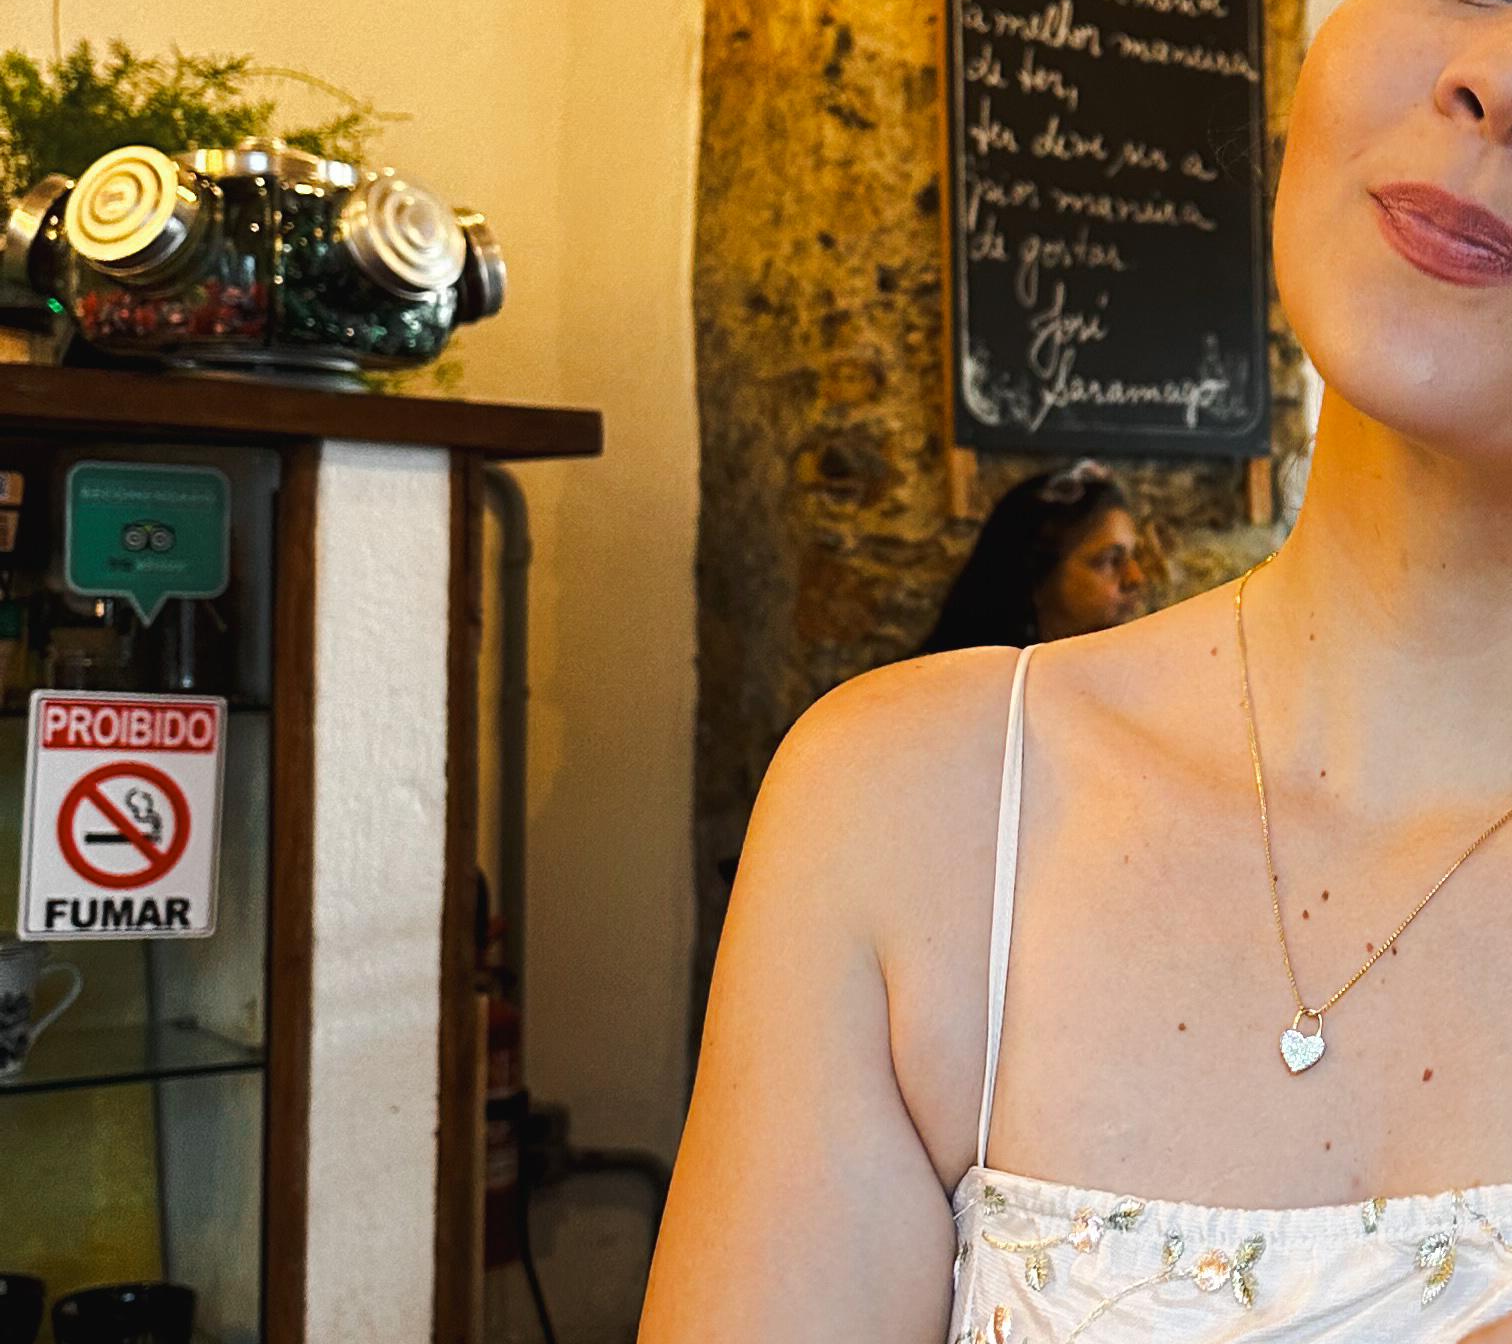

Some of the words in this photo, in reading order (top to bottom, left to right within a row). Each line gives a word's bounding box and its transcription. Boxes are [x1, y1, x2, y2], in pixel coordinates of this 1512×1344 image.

[967, 44, 1008, 89] de
[1106, 31, 1259, 83] maneira
[969, 213, 1008, 262] de
[45, 706, 213, 748] PROIBIDO
[45, 897, 191, 930] FUMAR
